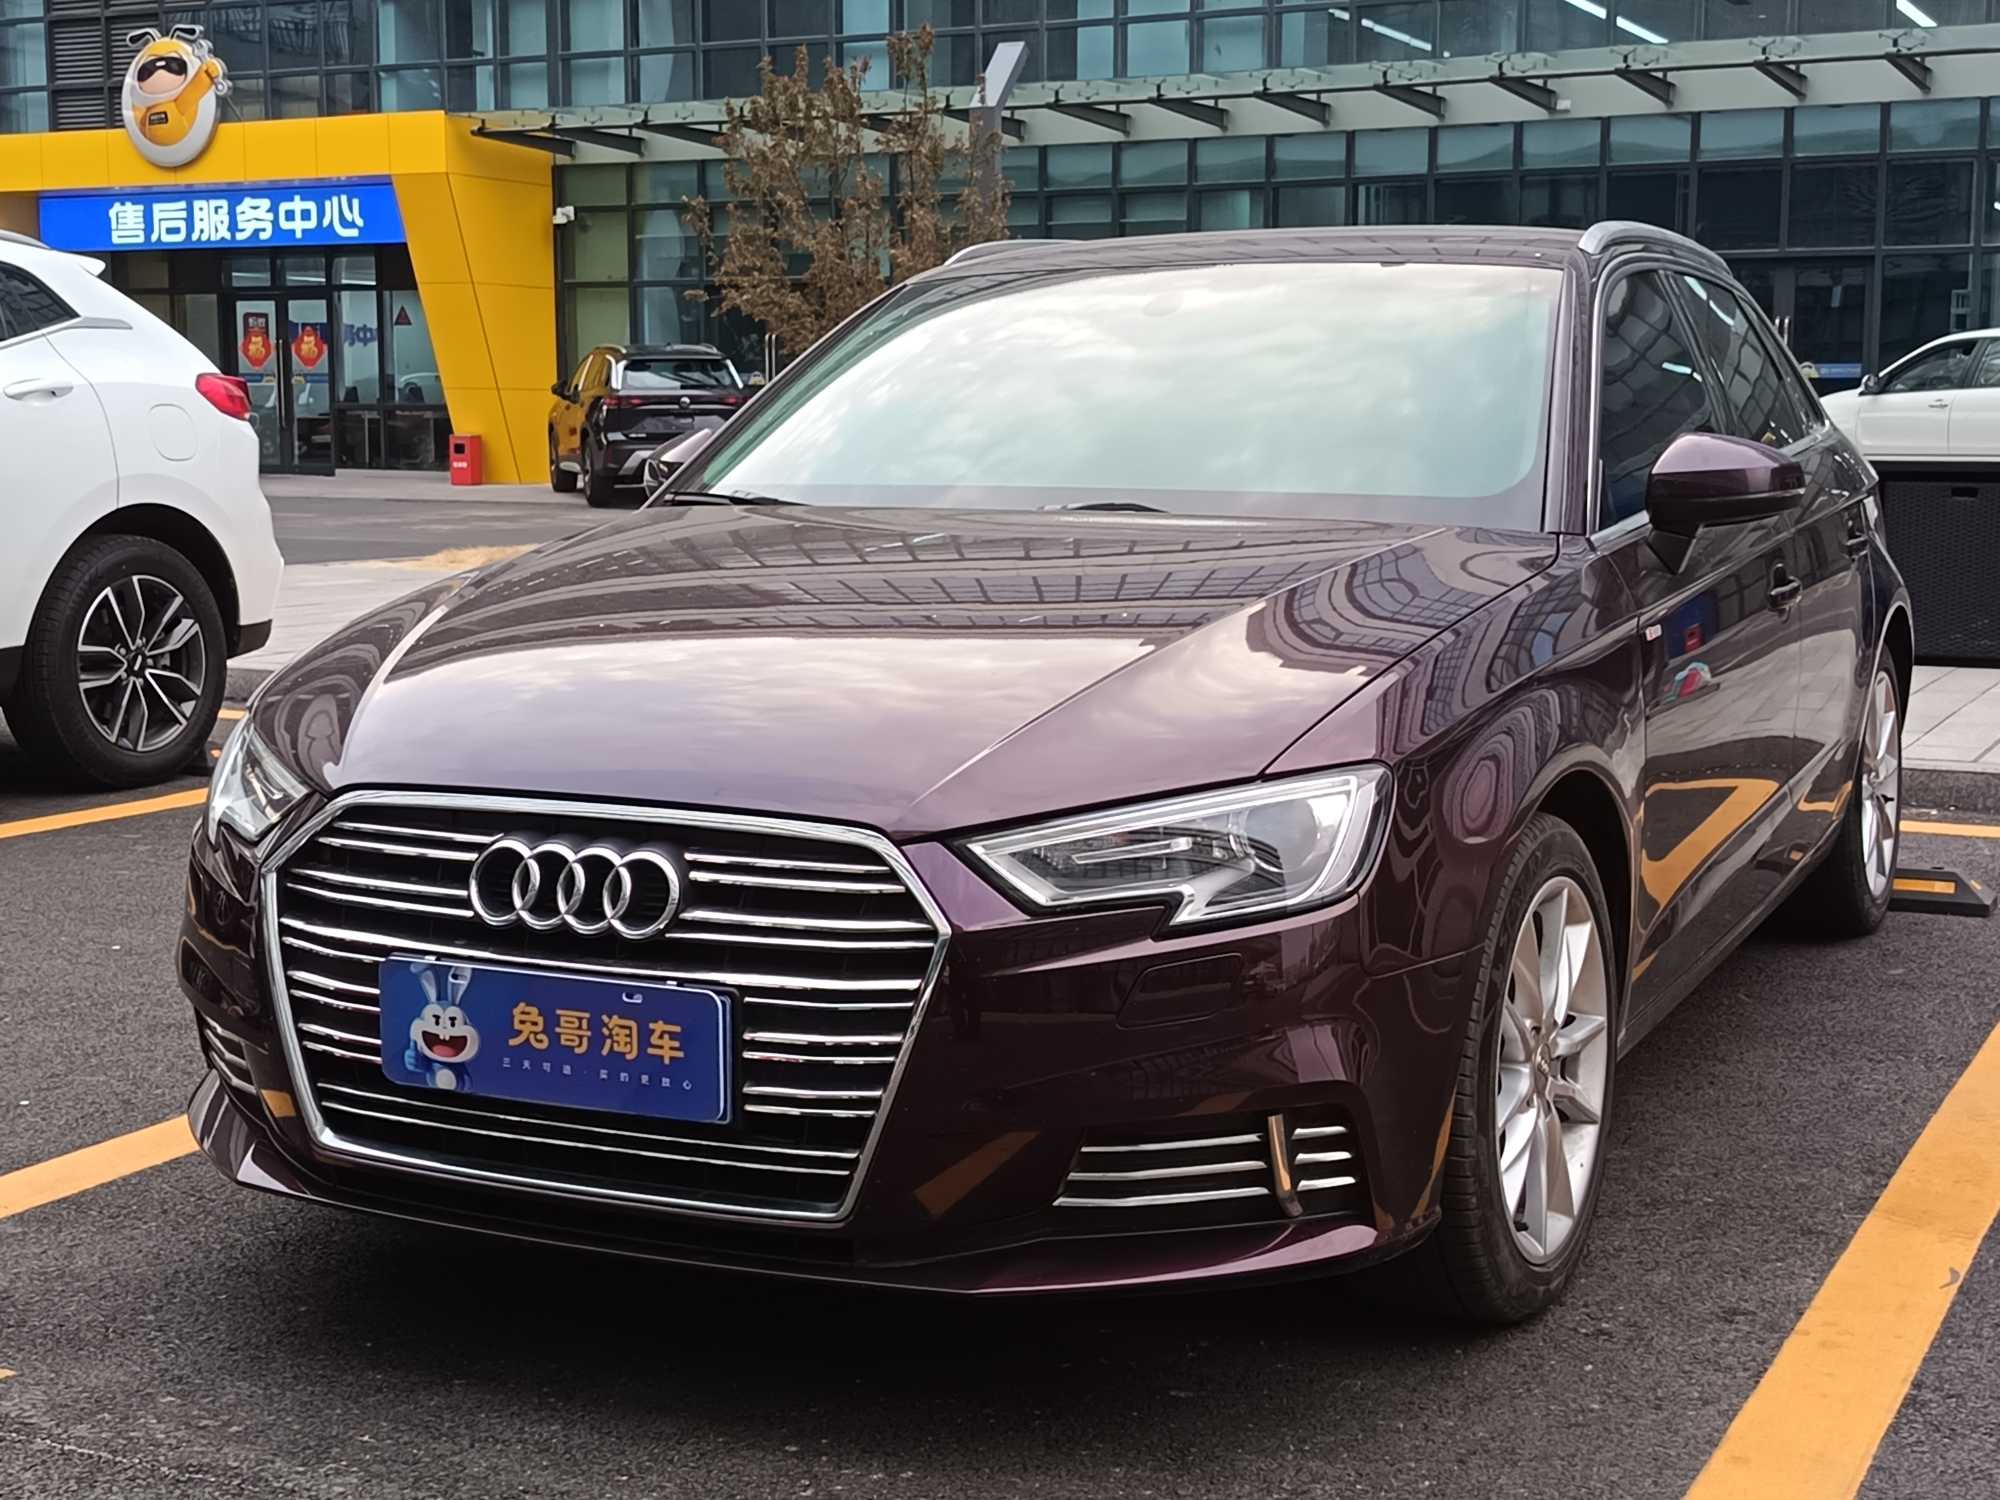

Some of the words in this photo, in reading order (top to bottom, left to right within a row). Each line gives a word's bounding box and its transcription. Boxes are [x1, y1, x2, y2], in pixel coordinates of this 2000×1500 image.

[109, 194, 364, 244] 售后服务中心
[508, 1001, 685, 1065] 兔哥淘车
